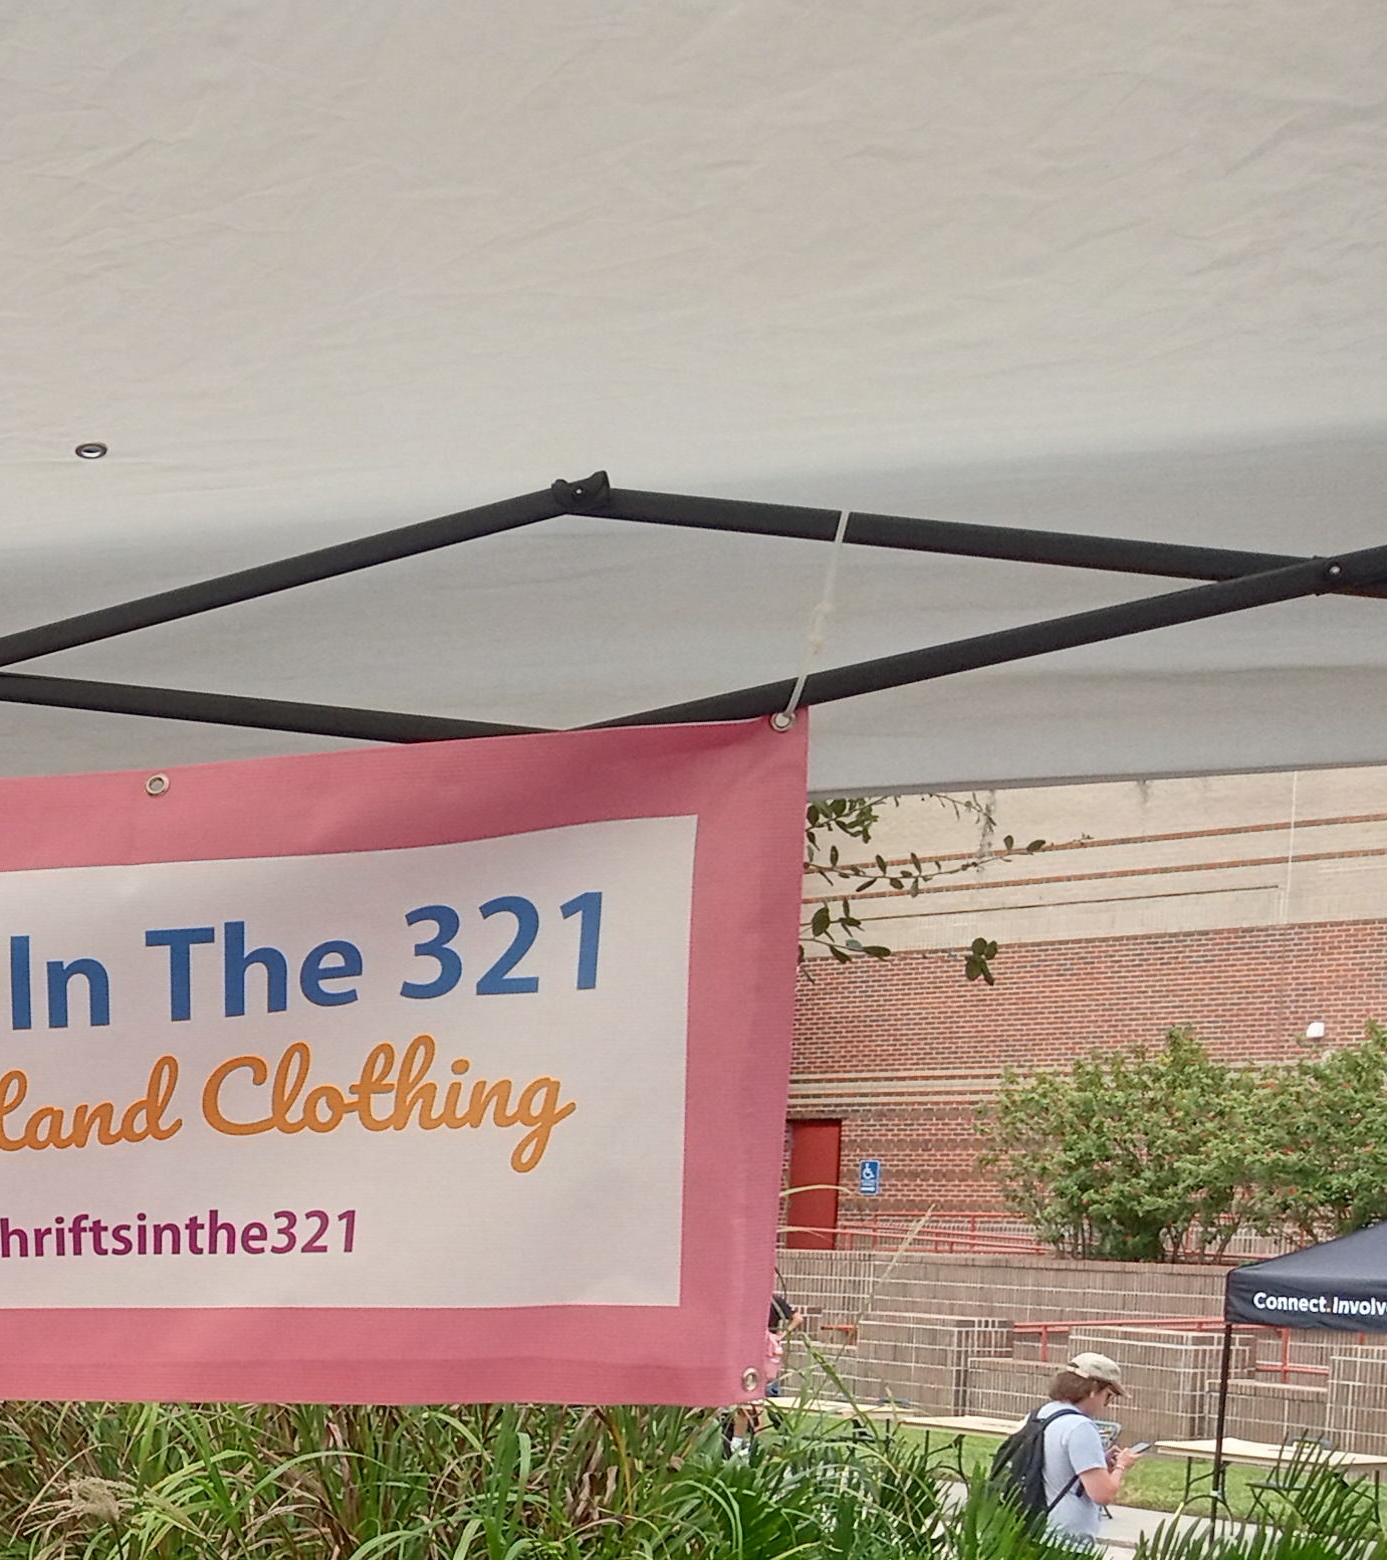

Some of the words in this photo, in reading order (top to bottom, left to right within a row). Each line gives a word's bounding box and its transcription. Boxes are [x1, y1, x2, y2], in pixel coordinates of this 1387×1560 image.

[11, 933, 114, 1031] In
[144, 916, 364, 1026] The
[401, 890, 603, 998] 321
[200, 1034, 578, 1173] Clothing
[1253, 1291, 1387, 1316] Connect.Involv
